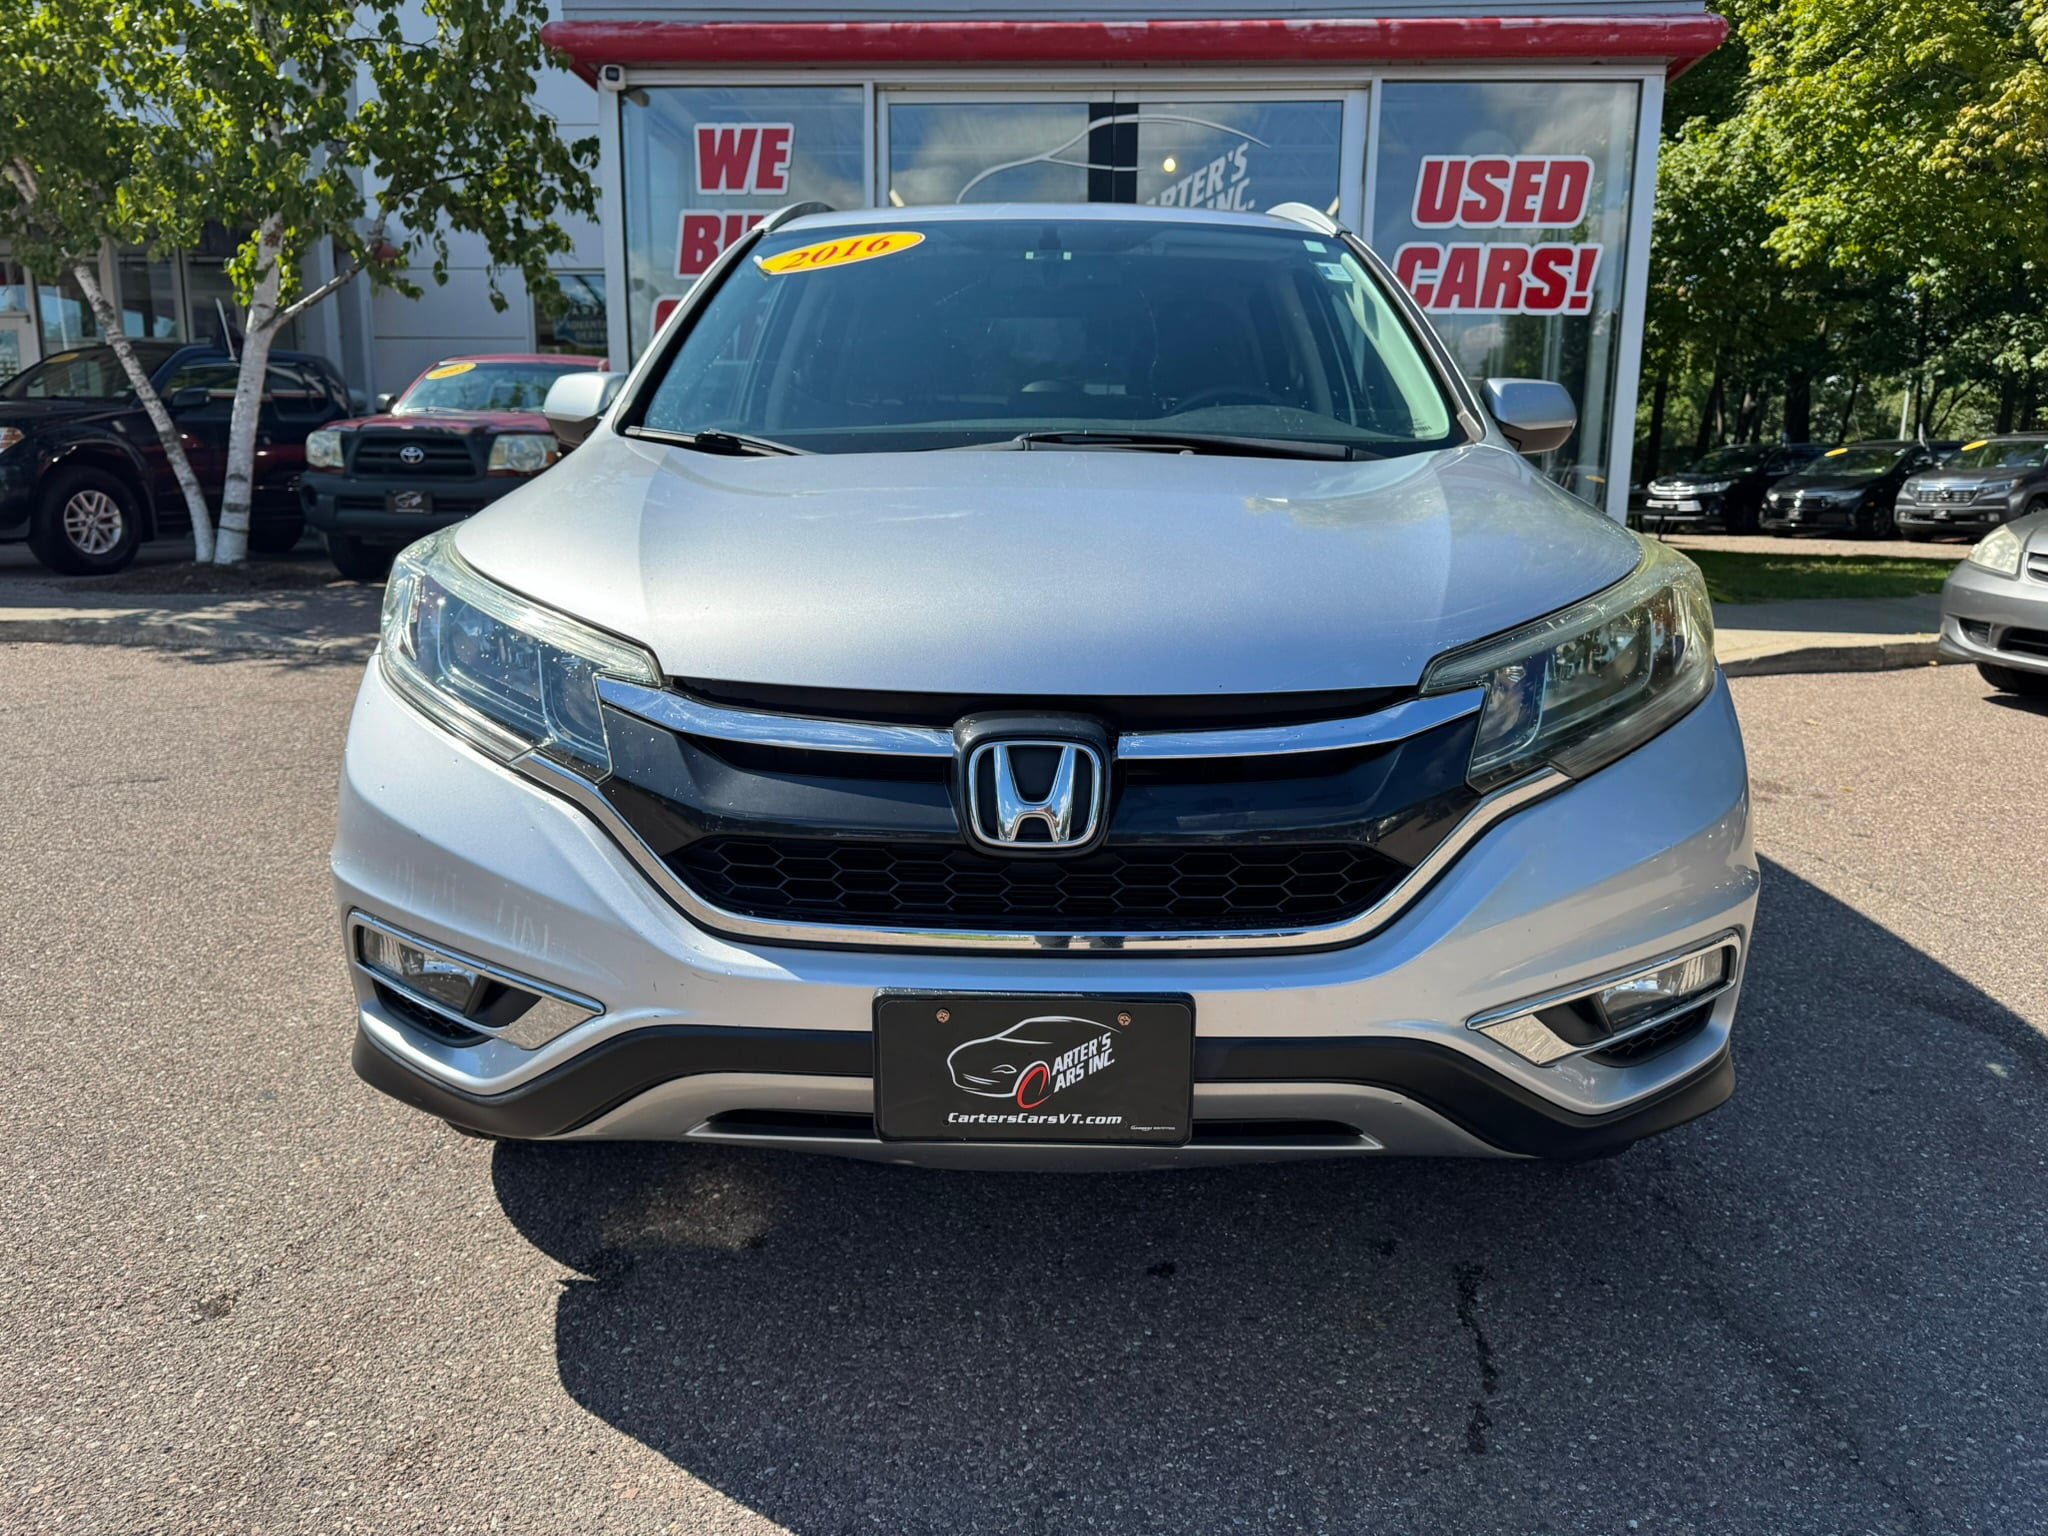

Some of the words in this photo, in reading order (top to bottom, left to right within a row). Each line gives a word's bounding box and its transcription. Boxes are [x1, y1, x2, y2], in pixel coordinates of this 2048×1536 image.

[696, 126, 792, 192] WE
[1415, 157, 1591, 225] USED
[780, 234, 896, 270] 2016
[1395, 245, 1599, 311] CARS!
[1088, 1048, 1115, 1076] INC.
[947, 1112, 1123, 1125] CartersCarsVT.com
